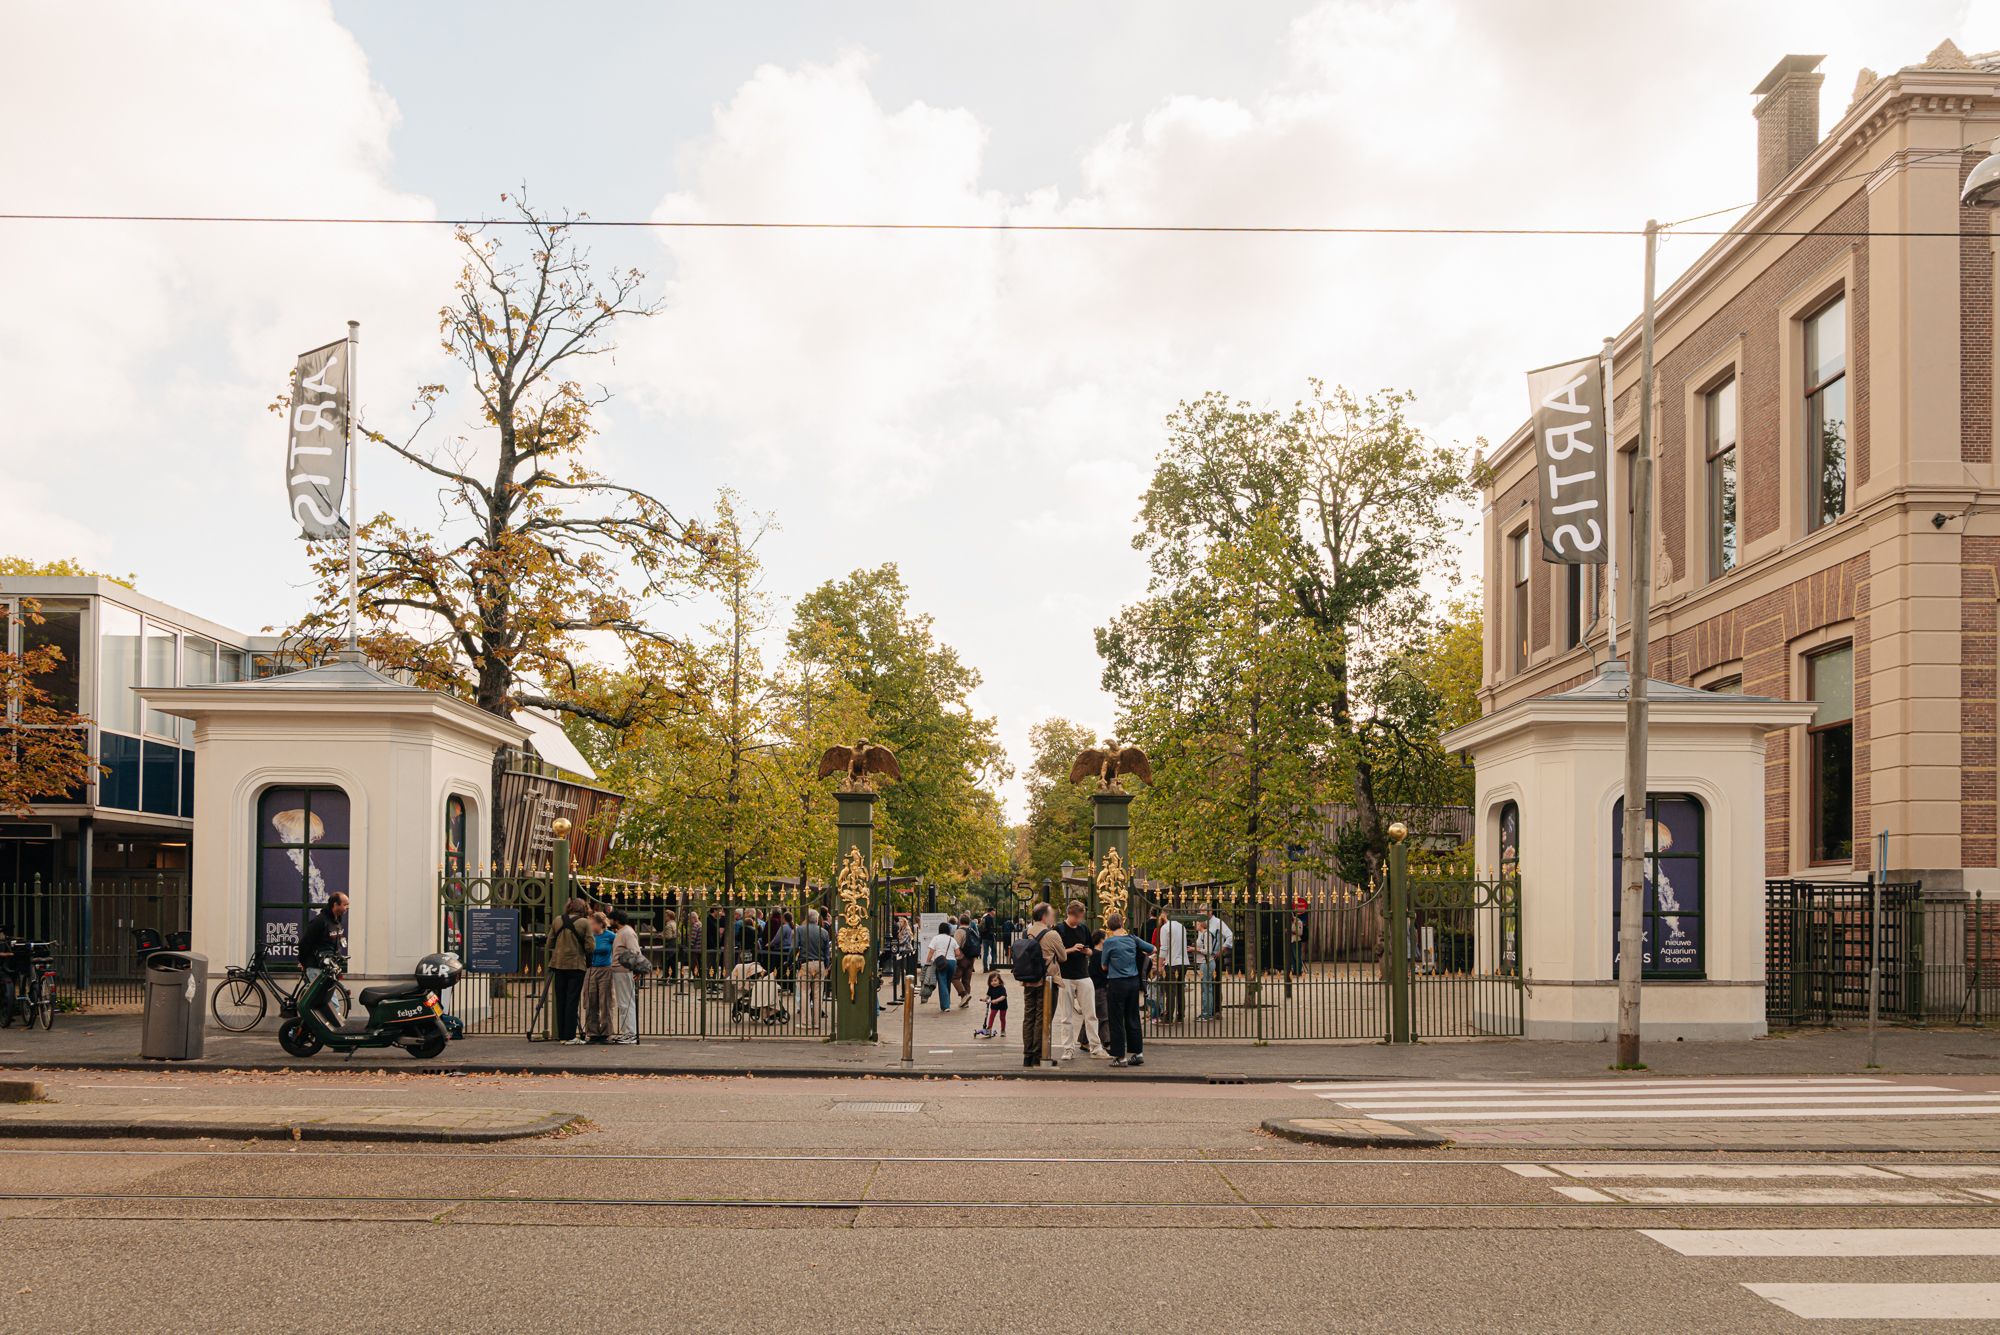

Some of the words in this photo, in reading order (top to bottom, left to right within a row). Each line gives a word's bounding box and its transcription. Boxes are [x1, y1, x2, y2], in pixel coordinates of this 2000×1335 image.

[266, 922, 299, 935] DIVE
[1671, 930, 1686, 938] Het
[266, 934, 300, 946] INTO
[264, 945, 300, 956] ARTIS
[1672, 957, 1692, 965] open
